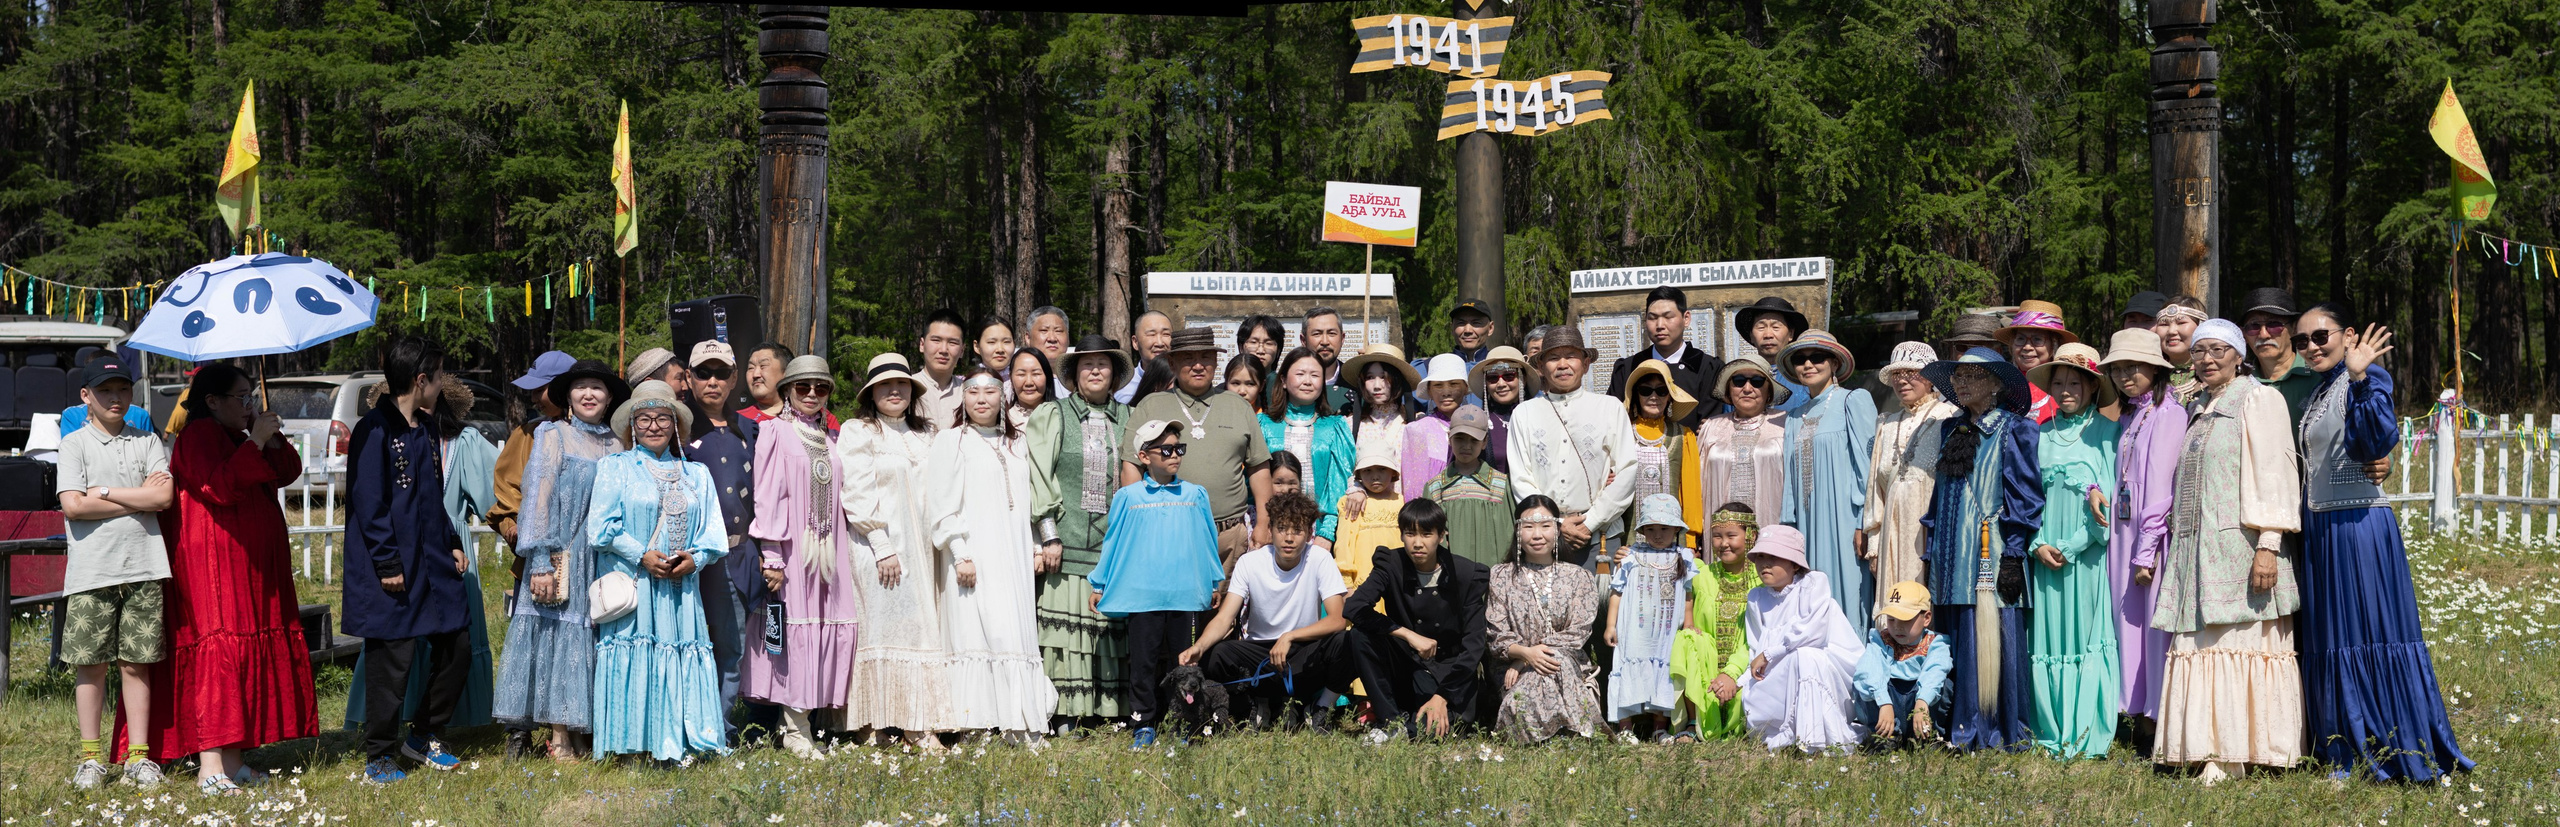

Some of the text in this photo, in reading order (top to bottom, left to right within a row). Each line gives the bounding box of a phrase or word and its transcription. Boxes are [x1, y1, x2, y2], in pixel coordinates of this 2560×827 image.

[1387, 15, 1485, 75] 1941
[1471, 74, 1576, 133] 1945
[1349, 193, 1401, 206] БАЙБАЛ
[1190, 276, 1351, 291] ЦЫПАНДИННАР
[1573, 261, 1820, 289] АЙМАХ СЭРИИ СЫЛЛАРЫГАР
[1889, 588, 1902, 604] LA
